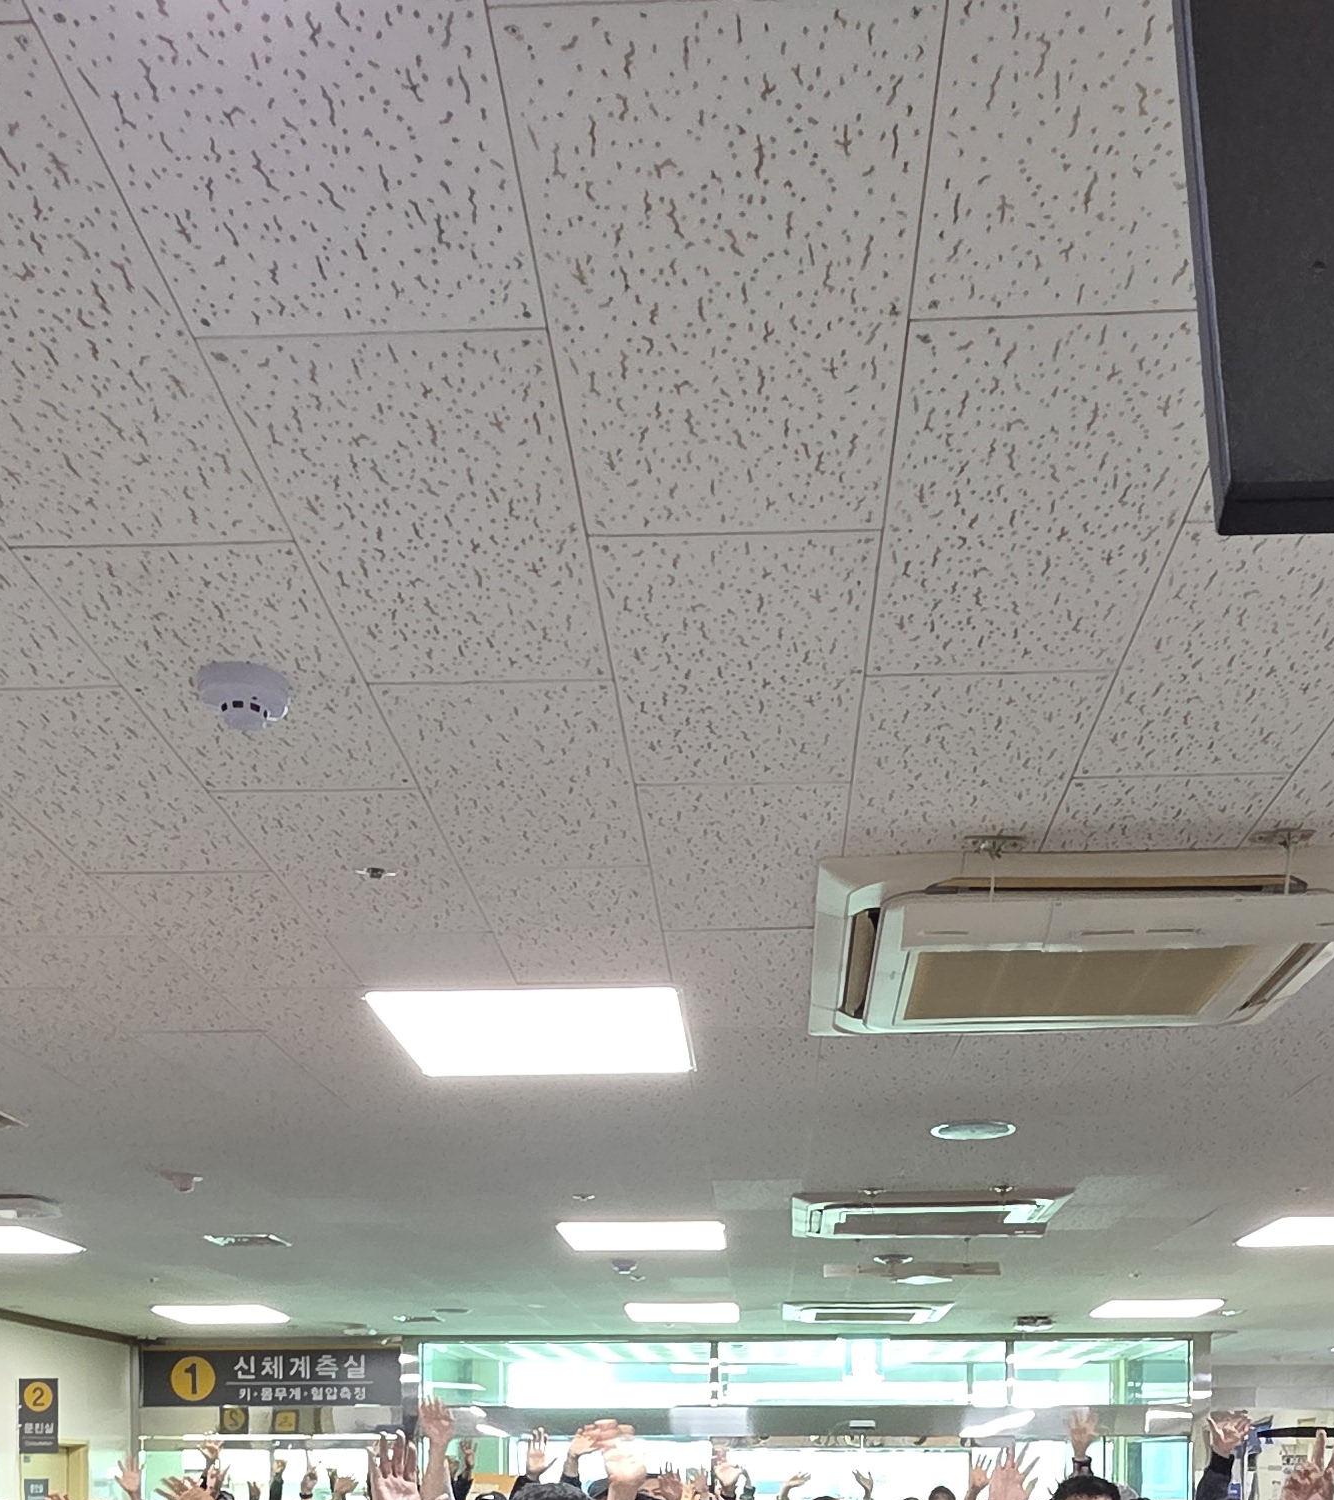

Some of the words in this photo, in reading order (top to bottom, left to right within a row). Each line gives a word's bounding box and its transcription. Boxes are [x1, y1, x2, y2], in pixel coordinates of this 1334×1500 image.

[184, 1362, 199, 1395] 1
[234, 1355, 367, 1380] 신체계측실
[32, 1386, 45, 1407] 2
